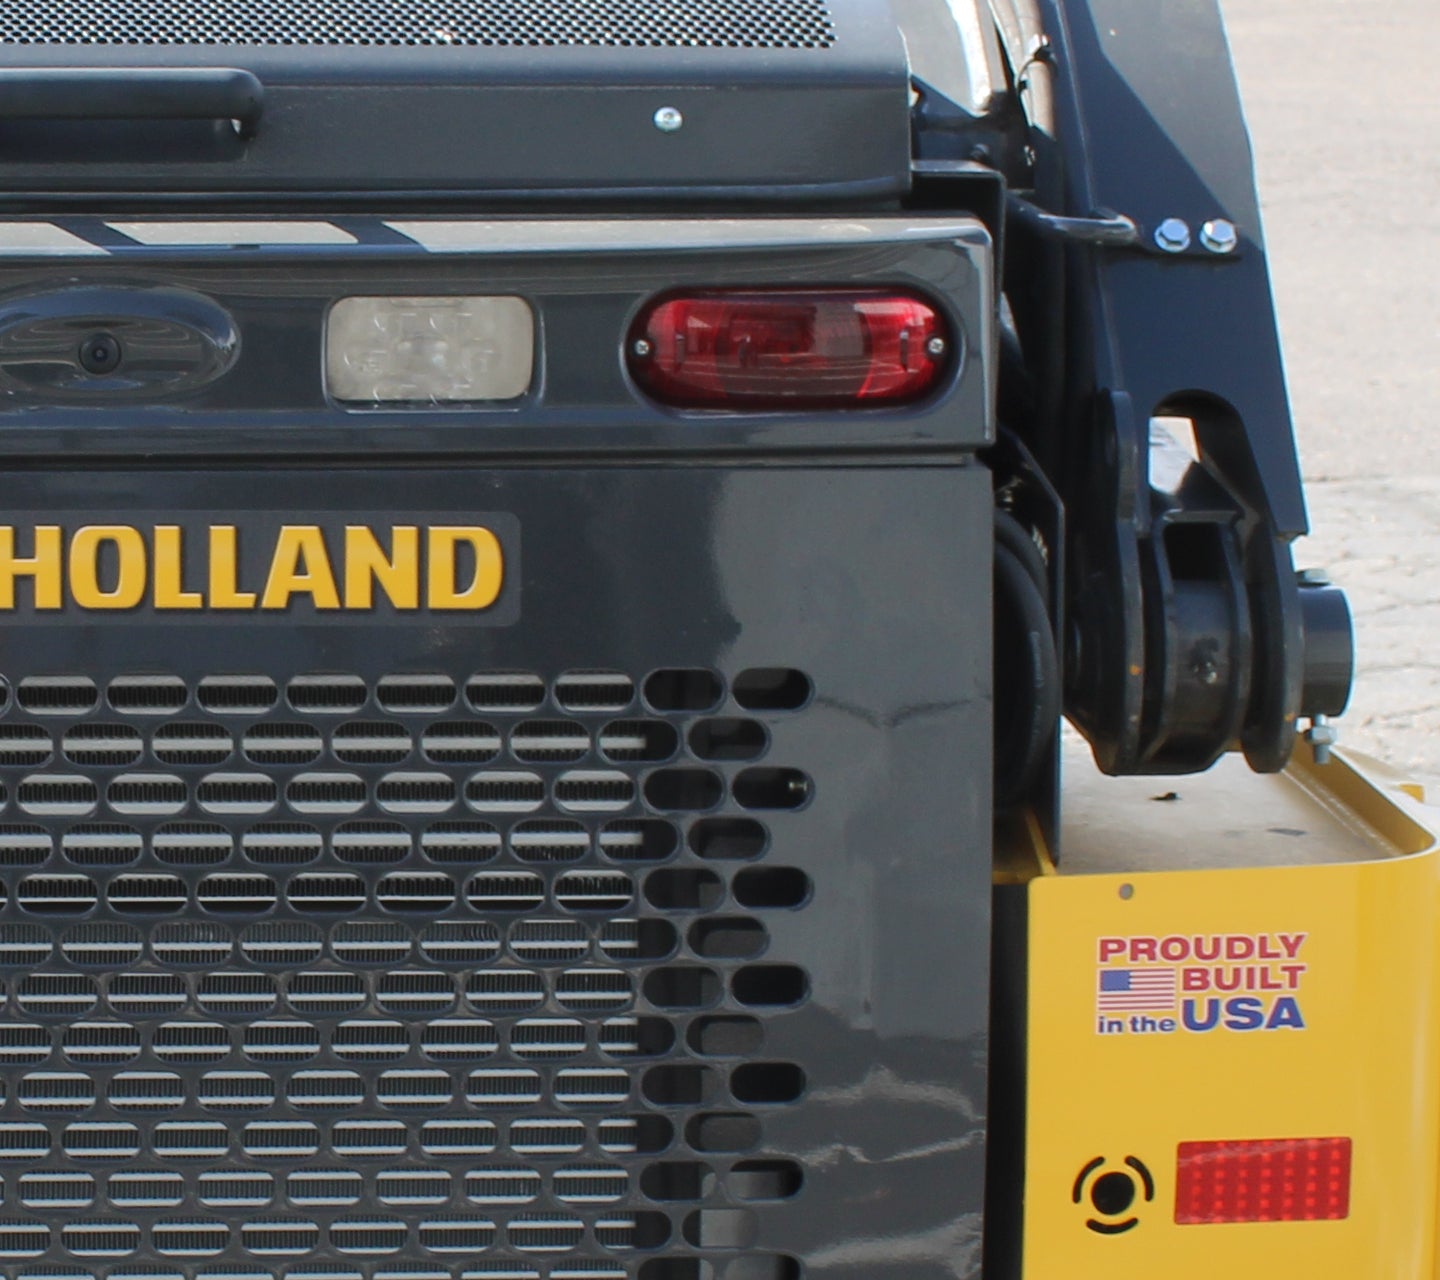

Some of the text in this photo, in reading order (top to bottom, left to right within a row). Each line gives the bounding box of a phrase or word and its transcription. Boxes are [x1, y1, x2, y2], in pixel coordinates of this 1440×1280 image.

[1098, 933, 1306, 963] PROUDLY
[1181, 965, 1307, 992] BUILT
[1097, 996, 1307, 1034] in the USA
